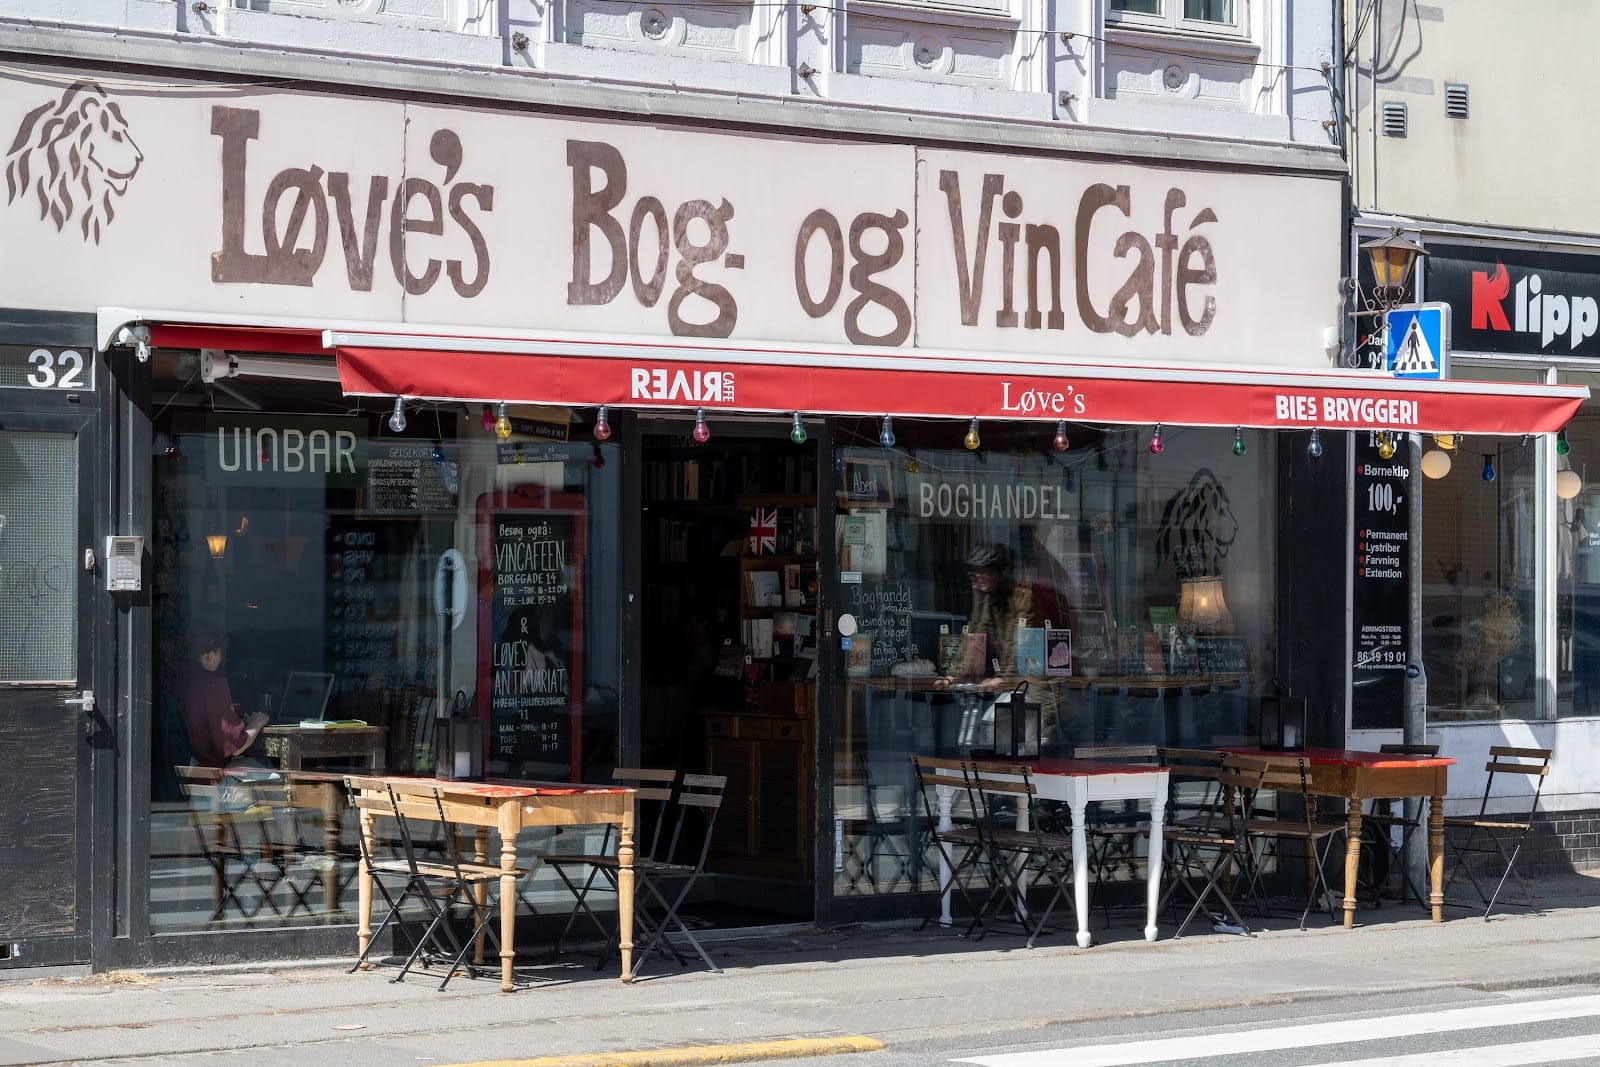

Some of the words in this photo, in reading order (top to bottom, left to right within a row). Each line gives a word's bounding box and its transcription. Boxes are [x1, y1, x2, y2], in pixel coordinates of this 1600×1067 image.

[795, 208, 912, 346] og
[26, 348, 85, 389] 32
[722, 371, 735, 403] CAFFE
[1001, 382, 1086, 415] Løve’s
[1322, 396, 1419, 425] BRYGGERI
[1364, 465, 1409, 481] Børneklip
[919, 481, 1071, 521] BOGHANDEL
[499, 523, 523, 541] Besøg
[527, 520, 552, 541] også:
[1365, 529, 1408, 541] Permanent
[1365, 542, 1401, 554] Lystriber
[1365, 555, 1400, 567] Farvning
[497, 573, 544, 585] BORGGADE
[546, 572, 556, 585] 14
[1365, 568, 1402, 578] Extention
[850, 584, 912, 611] Boghandel
[520, 617, 528, 634] &
[900, 614, 911, 630] af
[883, 627, 910, 641] bøger
[1357, 651, 1368, 662] 86
[1370, 651, 1381, 662] 19
[1383, 651, 1394, 662] 19
[1395, 651, 1406, 663] 01
[518, 708, 529, 720] 71
